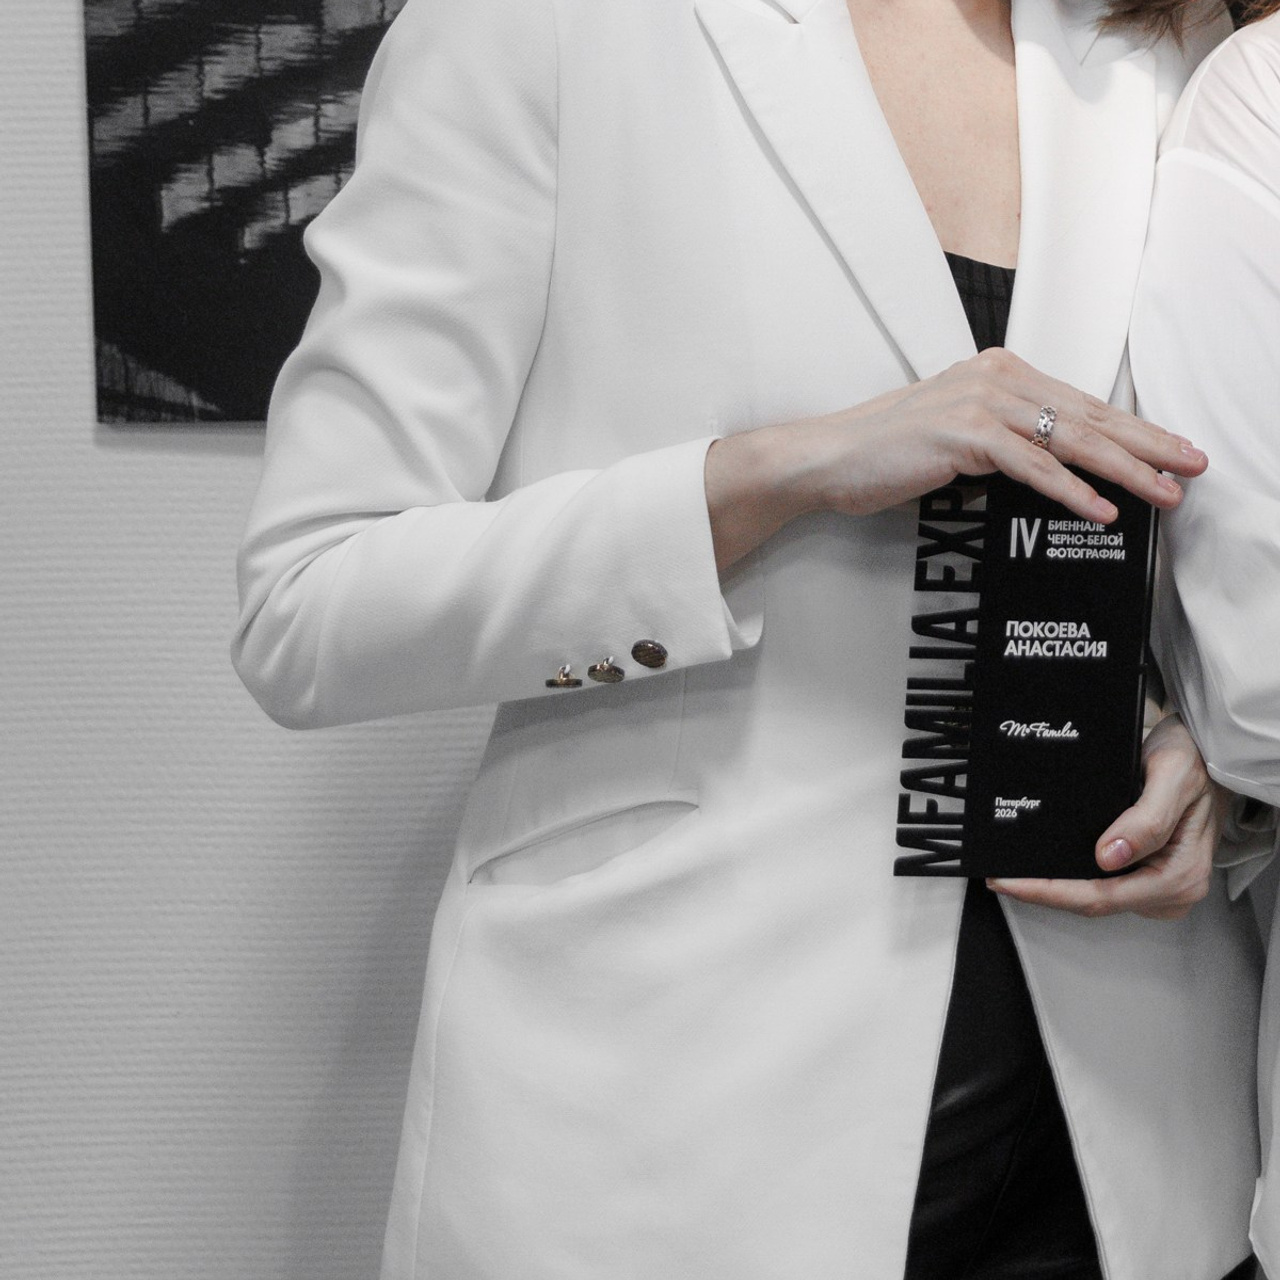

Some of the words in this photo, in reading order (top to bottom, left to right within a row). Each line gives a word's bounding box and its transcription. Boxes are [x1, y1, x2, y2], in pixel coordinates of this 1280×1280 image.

[1048, 520, 1106, 532] БИЕННАЛЕ
[1009, 517, 1042, 558] IV
[1047, 532, 1124, 547] ЧЕРНО-БЕЛОЙ
[1046, 547, 1126, 560] ФОТОГРАФИИ
[1005, 620, 1091, 638] ПОКОЕВА
[1003, 639, 1107, 657] АНАСТАСИЯ
[995, 796, 1041, 809] Петербург
[994, 808, 1018, 818] 2026
